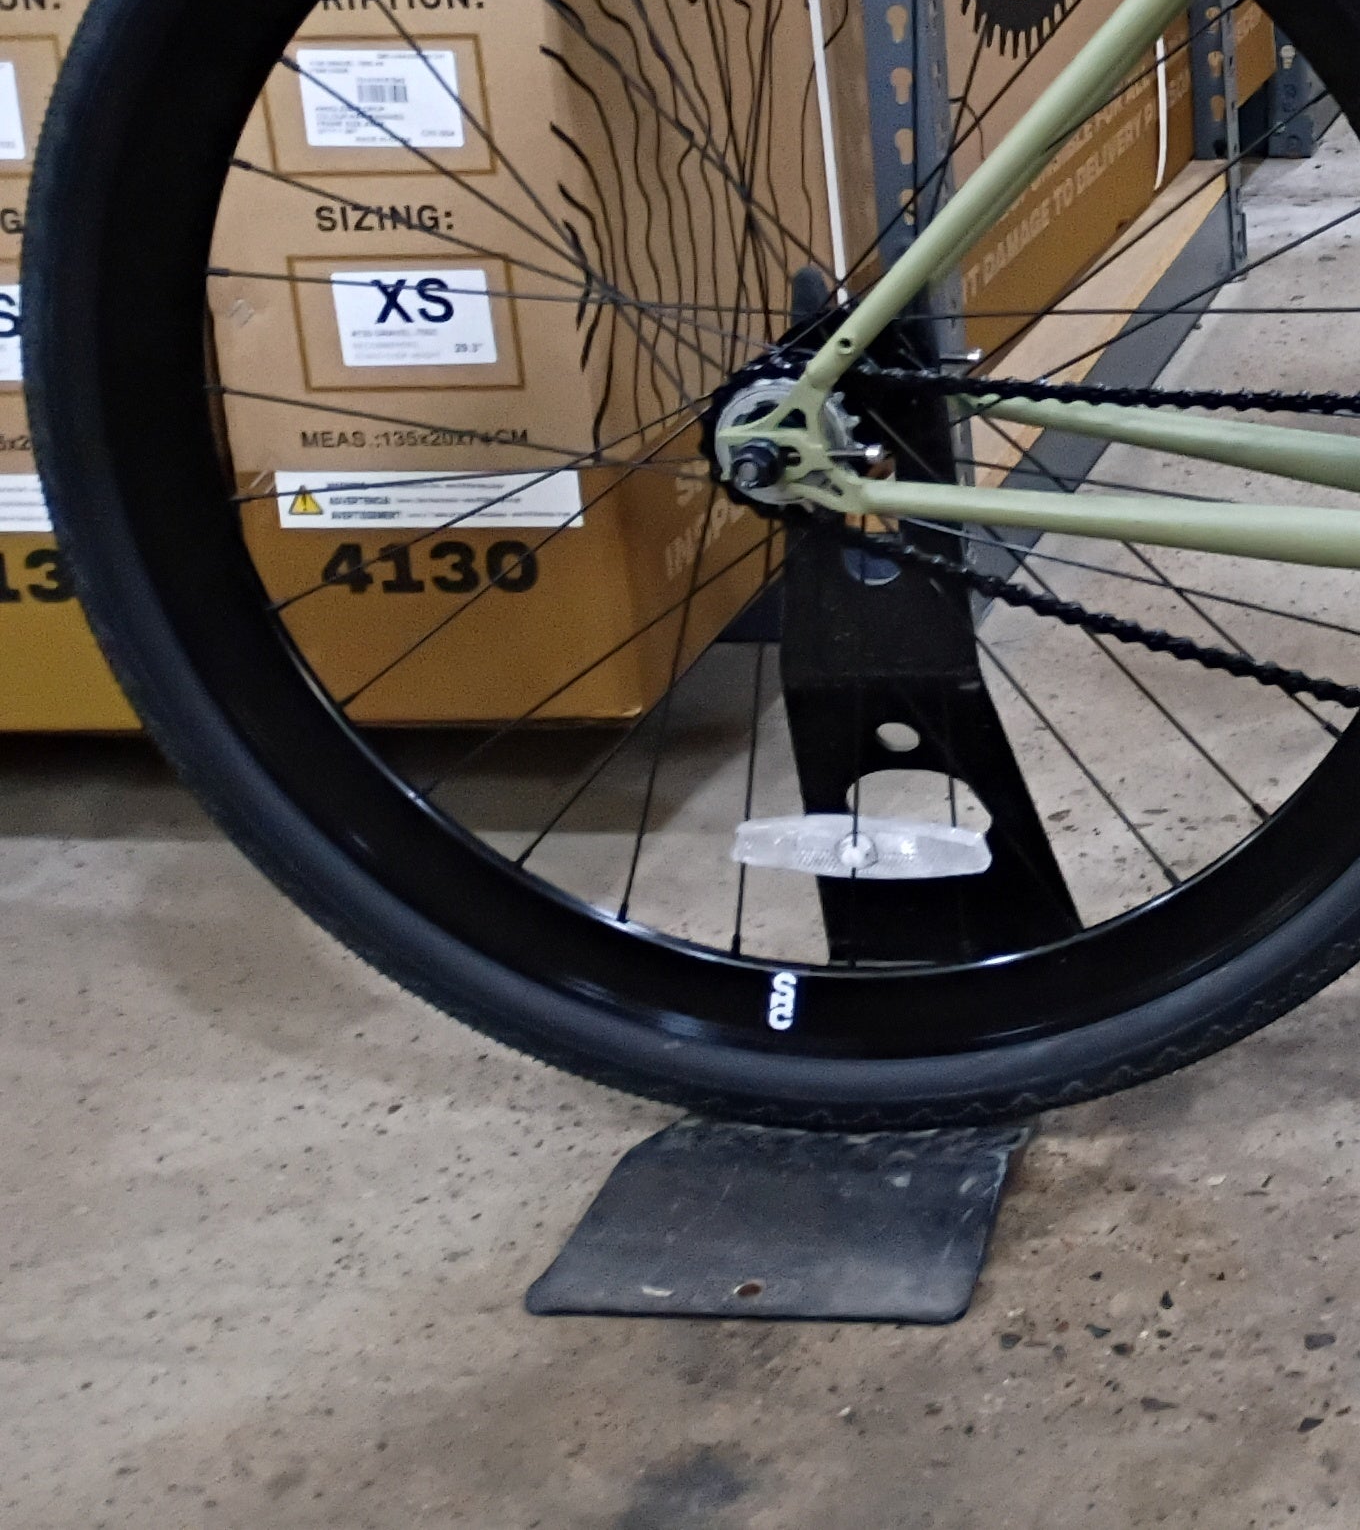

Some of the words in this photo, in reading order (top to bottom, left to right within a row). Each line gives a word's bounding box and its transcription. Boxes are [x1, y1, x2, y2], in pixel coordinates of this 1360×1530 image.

[314, 204, 455, 233] SIZING:
[372, 277, 455, 324] XS
[0, 541, 84, 603] 13
[321, 541, 538, 596] 4130
